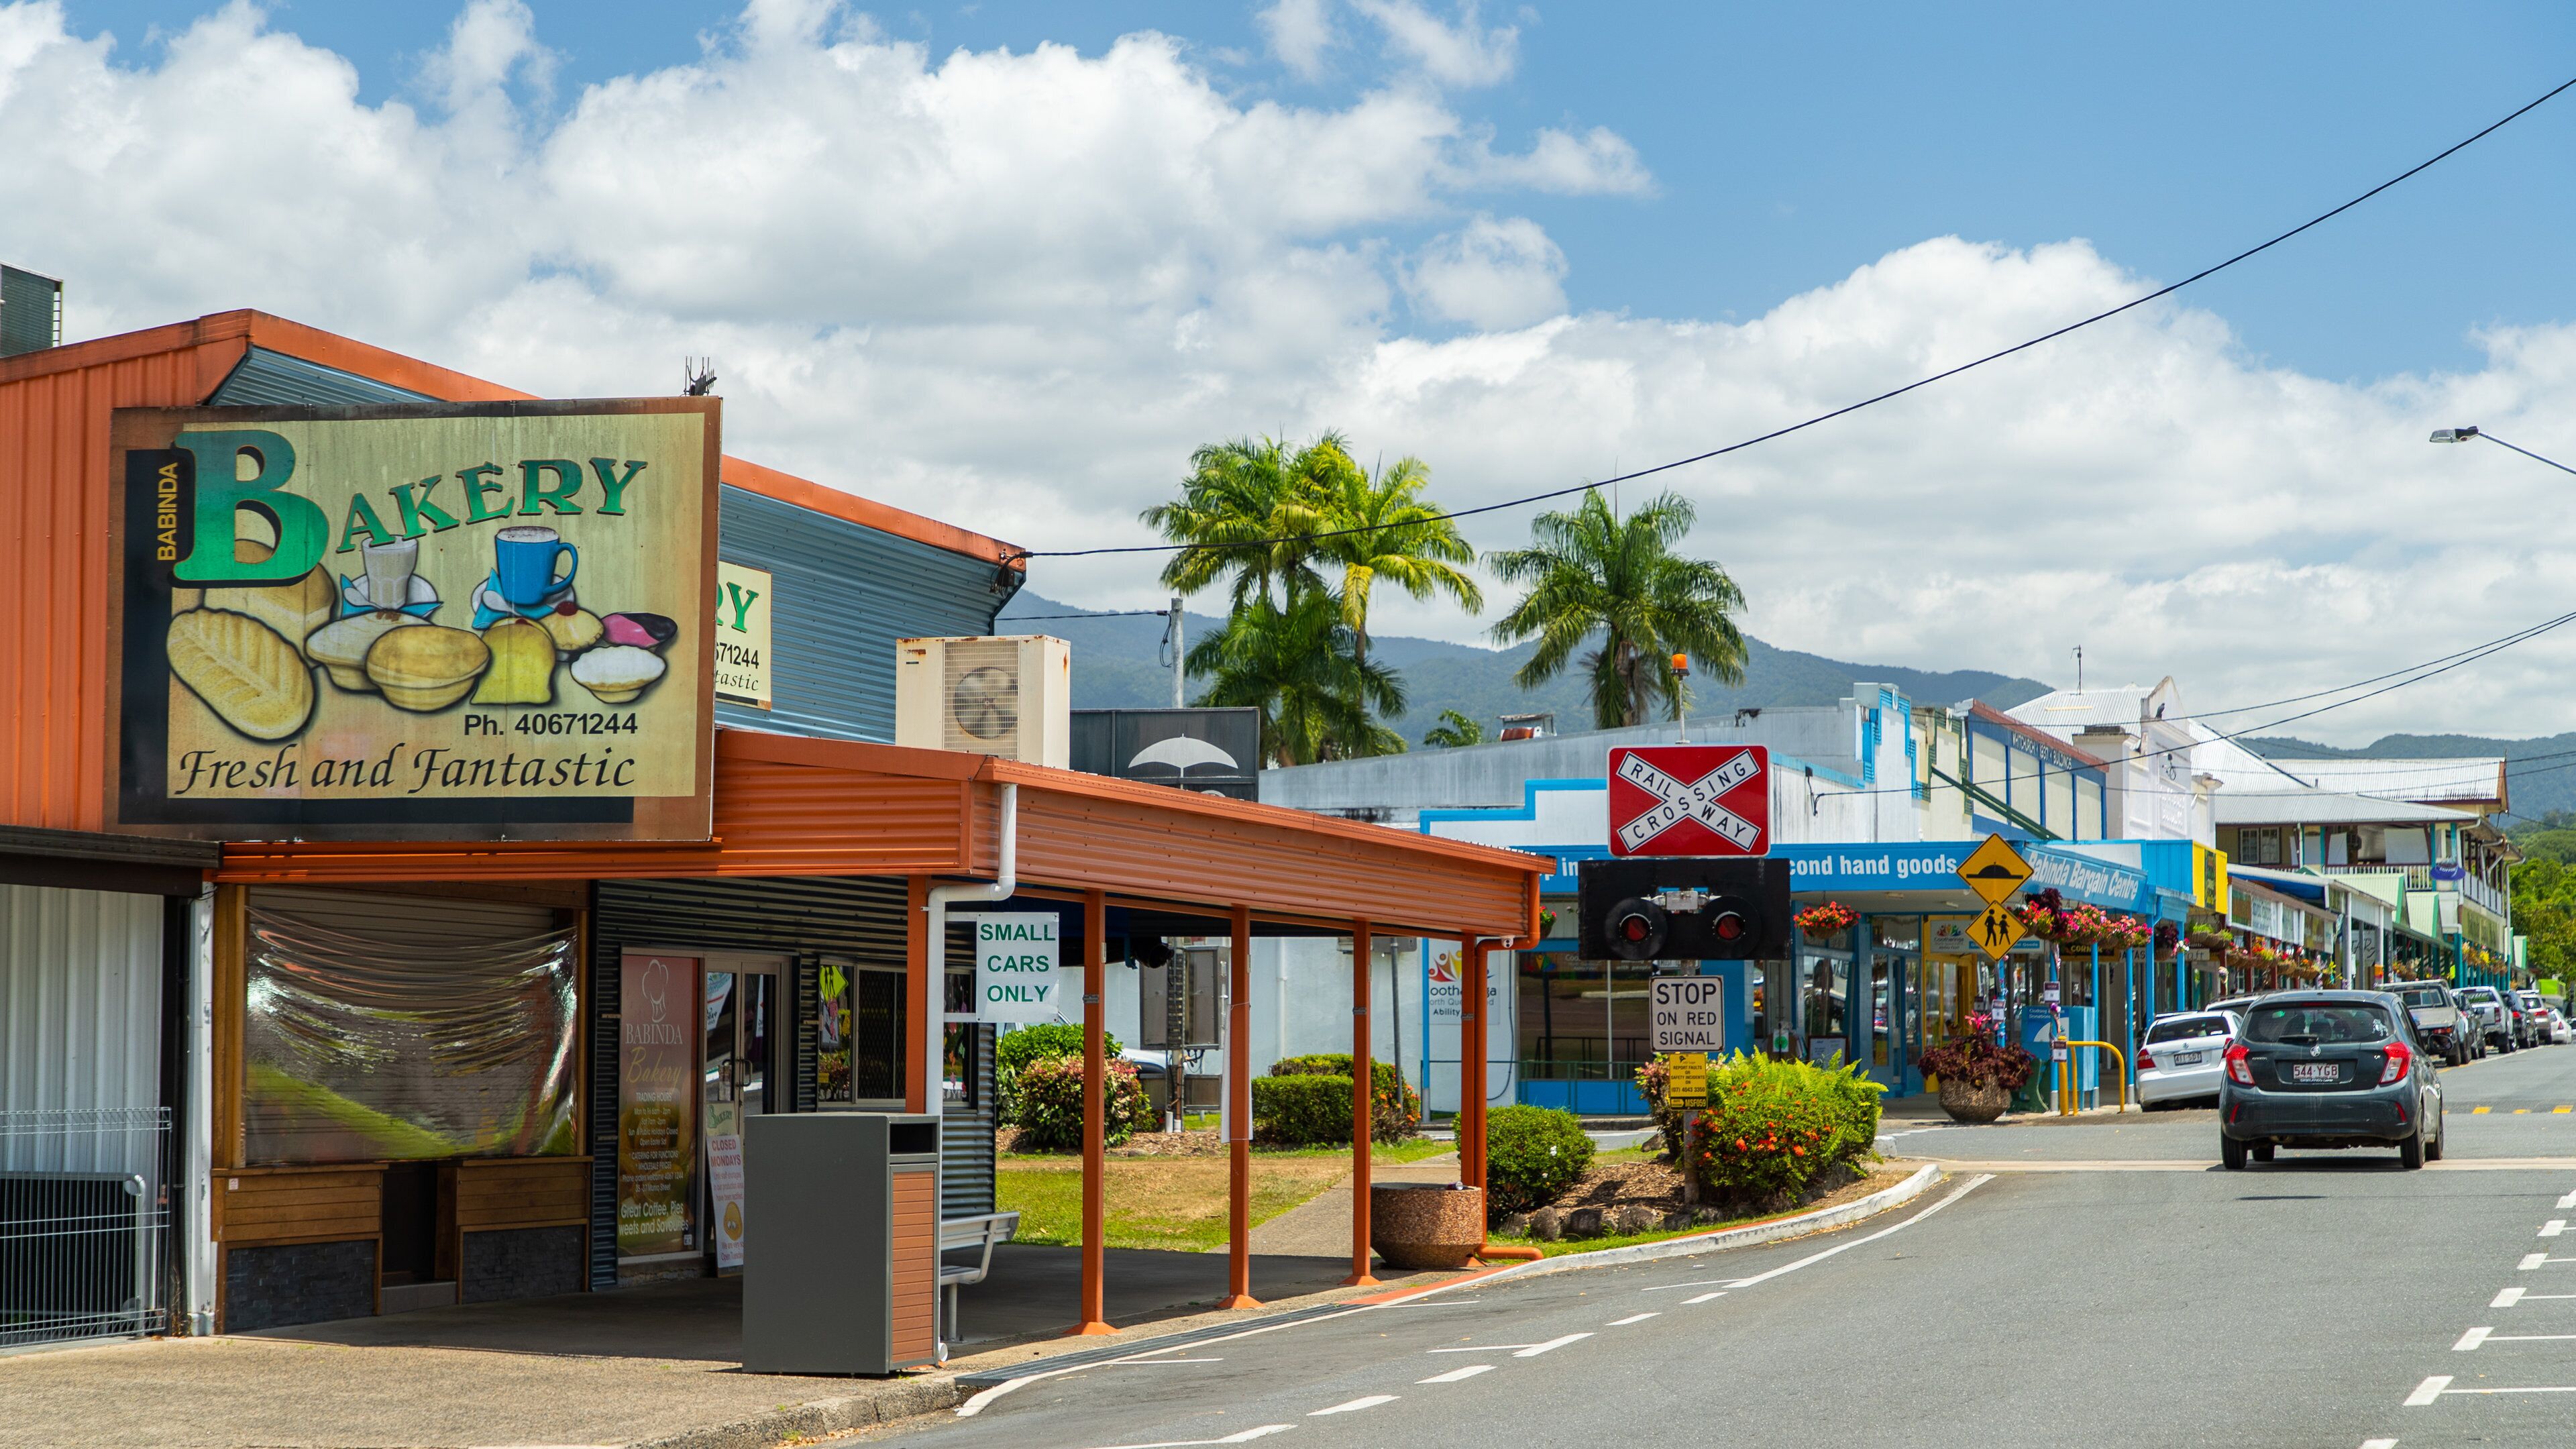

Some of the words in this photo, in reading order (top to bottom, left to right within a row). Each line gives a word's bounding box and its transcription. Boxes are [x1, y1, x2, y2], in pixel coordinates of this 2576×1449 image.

[156, 462, 179, 562] BABINDA
[172, 429, 648, 588] BAKERY
[465, 714, 504, 737] Ph.
[515, 712, 638, 735] 40671244
[174, 743, 301, 794] Fresh
[311, 743, 405, 788] and
[407, 747, 636, 794] Fantastic
[1633, 763, 1746, 839] CROSSING
[1789, 855, 1833, 875] cond
[1839, 855, 1889, 875] hand
[1897, 854, 1957, 879] goods
[2028, 851, 2070, 885] Babinda
[2069, 860, 2108, 898] Bargain
[2108, 871, 2139, 900] Centre
[980, 924, 1056, 941] SMALL
[987, 955, 1050, 972] CARS
[987, 985, 1049, 1002] ONLY
[1656, 983, 1717, 1004] STOP
[1433, 1008, 1460, 1017] Ability
[1657, 1012, 1676, 1025] ON
[1687, 1012, 1716, 1025] RED
[625, 1024, 683, 1044] BABINDA
[1660, 1031, 1715, 1045] SIGNAL
[626, 1046, 682, 1095] Bakery
[636, 1091, 656, 1102] TRADING
[657, 1091, 672, 1102] HOURS
[708, 1104, 733, 1128] BAKERY
[712, 1138, 737, 1152] CLOSED
[710, 1154, 741, 1167] MONDAYS
[621, 1202, 641, 1219] Great
[643, 1201, 669, 1217] Coffee,
[670, 1200, 684, 1214] Pies
[619, 1220, 639, 1236] weets
[641, 1218, 655, 1234] and
[656, 1218, 689, 1233] Savouries
